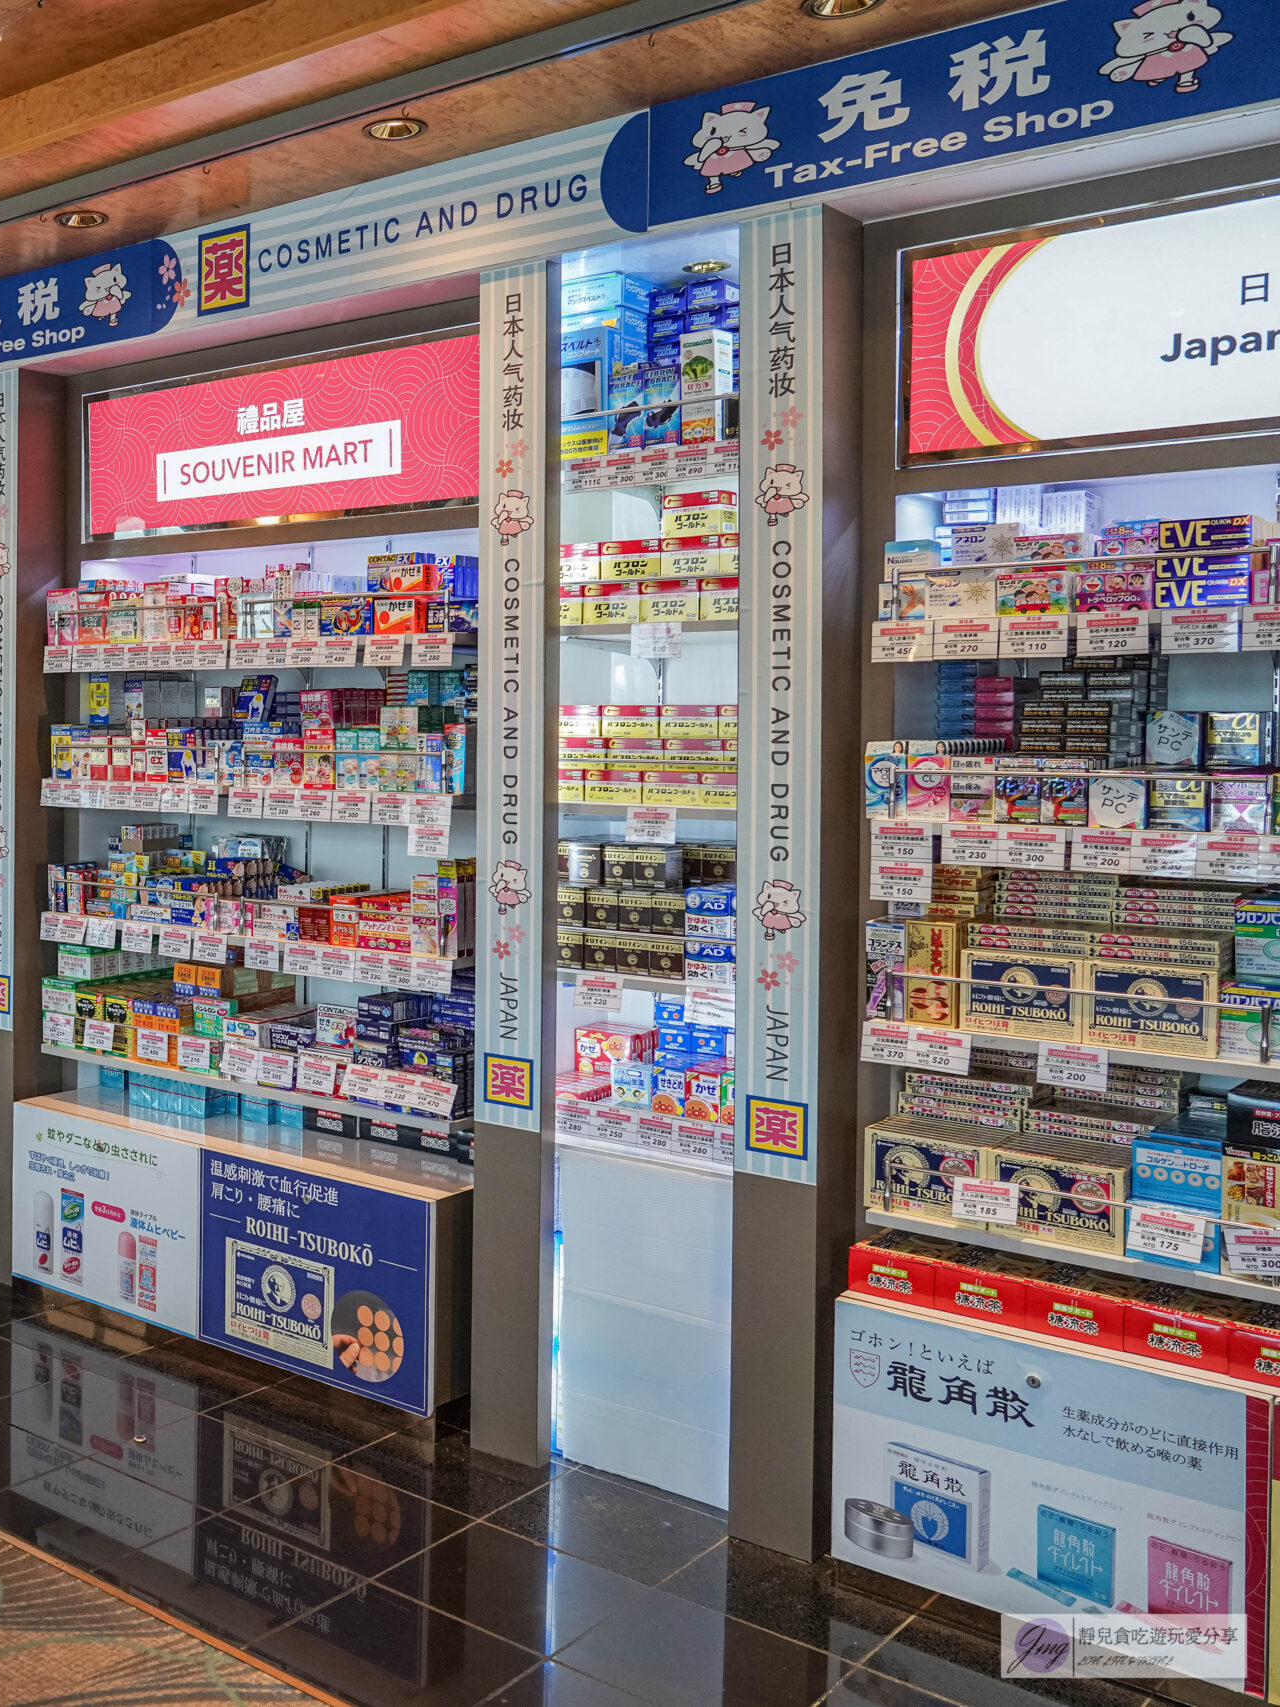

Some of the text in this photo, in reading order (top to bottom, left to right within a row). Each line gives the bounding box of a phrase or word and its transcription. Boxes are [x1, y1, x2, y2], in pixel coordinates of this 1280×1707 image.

[765, 99, 1114, 188] Tax-Free Shop
[259, 174, 588, 273] COSMETIC AND DRUG
[1241, 273, 1269, 305] 日
[768, 243, 797, 399] 日本人气药妆
[32, 325, 85, 347] Shop
[610, 375, 633, 383] KNEE
[645, 368, 675, 378] ELBOW
[650, 375, 678, 384] BRACE
[614, 380, 641, 389] BRACE
[236, 399, 305, 435] 禮品屋
[179, 440, 372, 485] SOUVENIR MART
[954, 535, 986, 544] アネロン
[1160, 520, 1210, 548] EVE
[1232, 516, 1250, 525] DX
[368, 553, 411, 564] CONTAC EX
[1157, 557, 1208, 578] EVE
[1155, 580, 1207, 608] EVE
[1229, 576, 1248, 586] DX
[1108, 640, 1127, 648] 120
[1194, 637, 1214, 645] 370
[502, 558, 520, 844] COSMETIC AND DRUG
[769, 540, 792, 862] COSMETIC AND DRUG
[1157, 736, 1183, 751] PC
[1101, 784, 1138, 802] サンテ
[1101, 798, 1127, 814] PC
[646, 830, 660, 838] 520
[1101, 858, 1120, 866] 200
[703, 902, 725, 910] AD
[687, 916, 713, 925] かゆみに
[499, 972, 518, 1041] JAPAN
[766, 1004, 789, 1083] JAPAN
[660, 1078, 684, 1091] せきどめ
[1066, 1073, 1086, 1081] 200
[695, 1082, 716, 1096] かぜ
[692, 1146, 707, 1155] 280
[210, 1159, 339, 1206] 温感刺激で血行促進
[130, 1217, 186, 1240] 液体ムヒベビー
[1160, 1240, 1179, 1251] 175
[868, 1274, 912, 1294] 糖流茶
[955, 1292, 1002, 1314] 糖流茶
[1048, 1312, 1099, 1336] 糖流茶
[1148, 1334, 1202, 1358] 糖流茶
[886, 1361, 1035, 1428] 龍角散
[1062, 1406, 1239, 1460] 生薬成分がのどに直接作用
[1062, 1425, 1202, 1471] 水なしで飲める喉の薬
[898, 1460, 966, 1496] 龍角散
[1053, 1528, 1095, 1558] 龍角散
[1165, 1561, 1210, 1592] 龍角散
